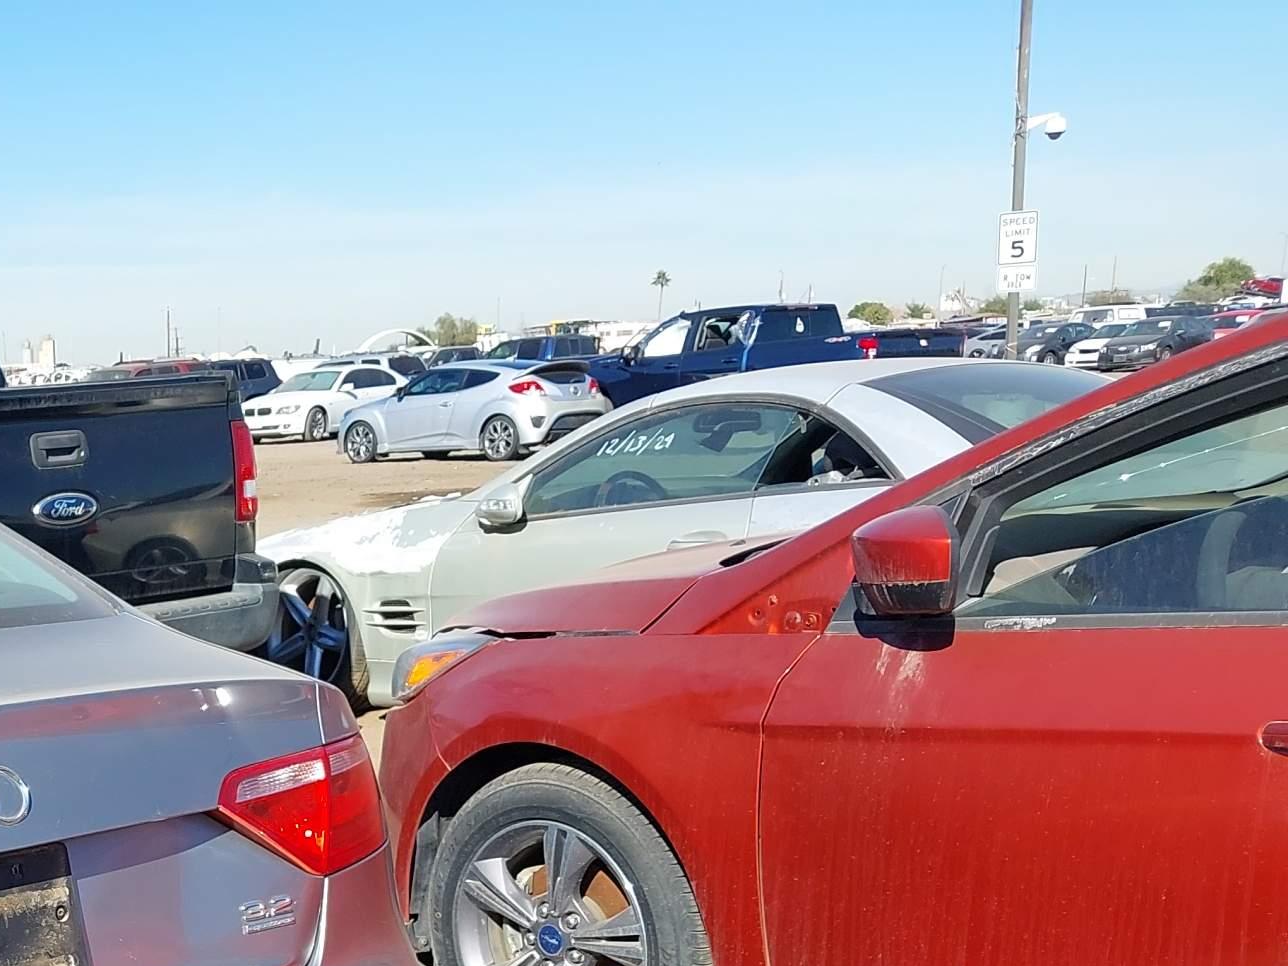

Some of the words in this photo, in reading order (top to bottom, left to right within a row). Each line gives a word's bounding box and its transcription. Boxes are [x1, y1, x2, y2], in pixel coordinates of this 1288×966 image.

[1002, 217, 1036, 227] SPEED
[1005, 228, 1031, 238] LIMIT
[1010, 240, 1025, 258] 5
[51, 498, 85, 518] Ford
[239, 895, 294, 922] 3.2
